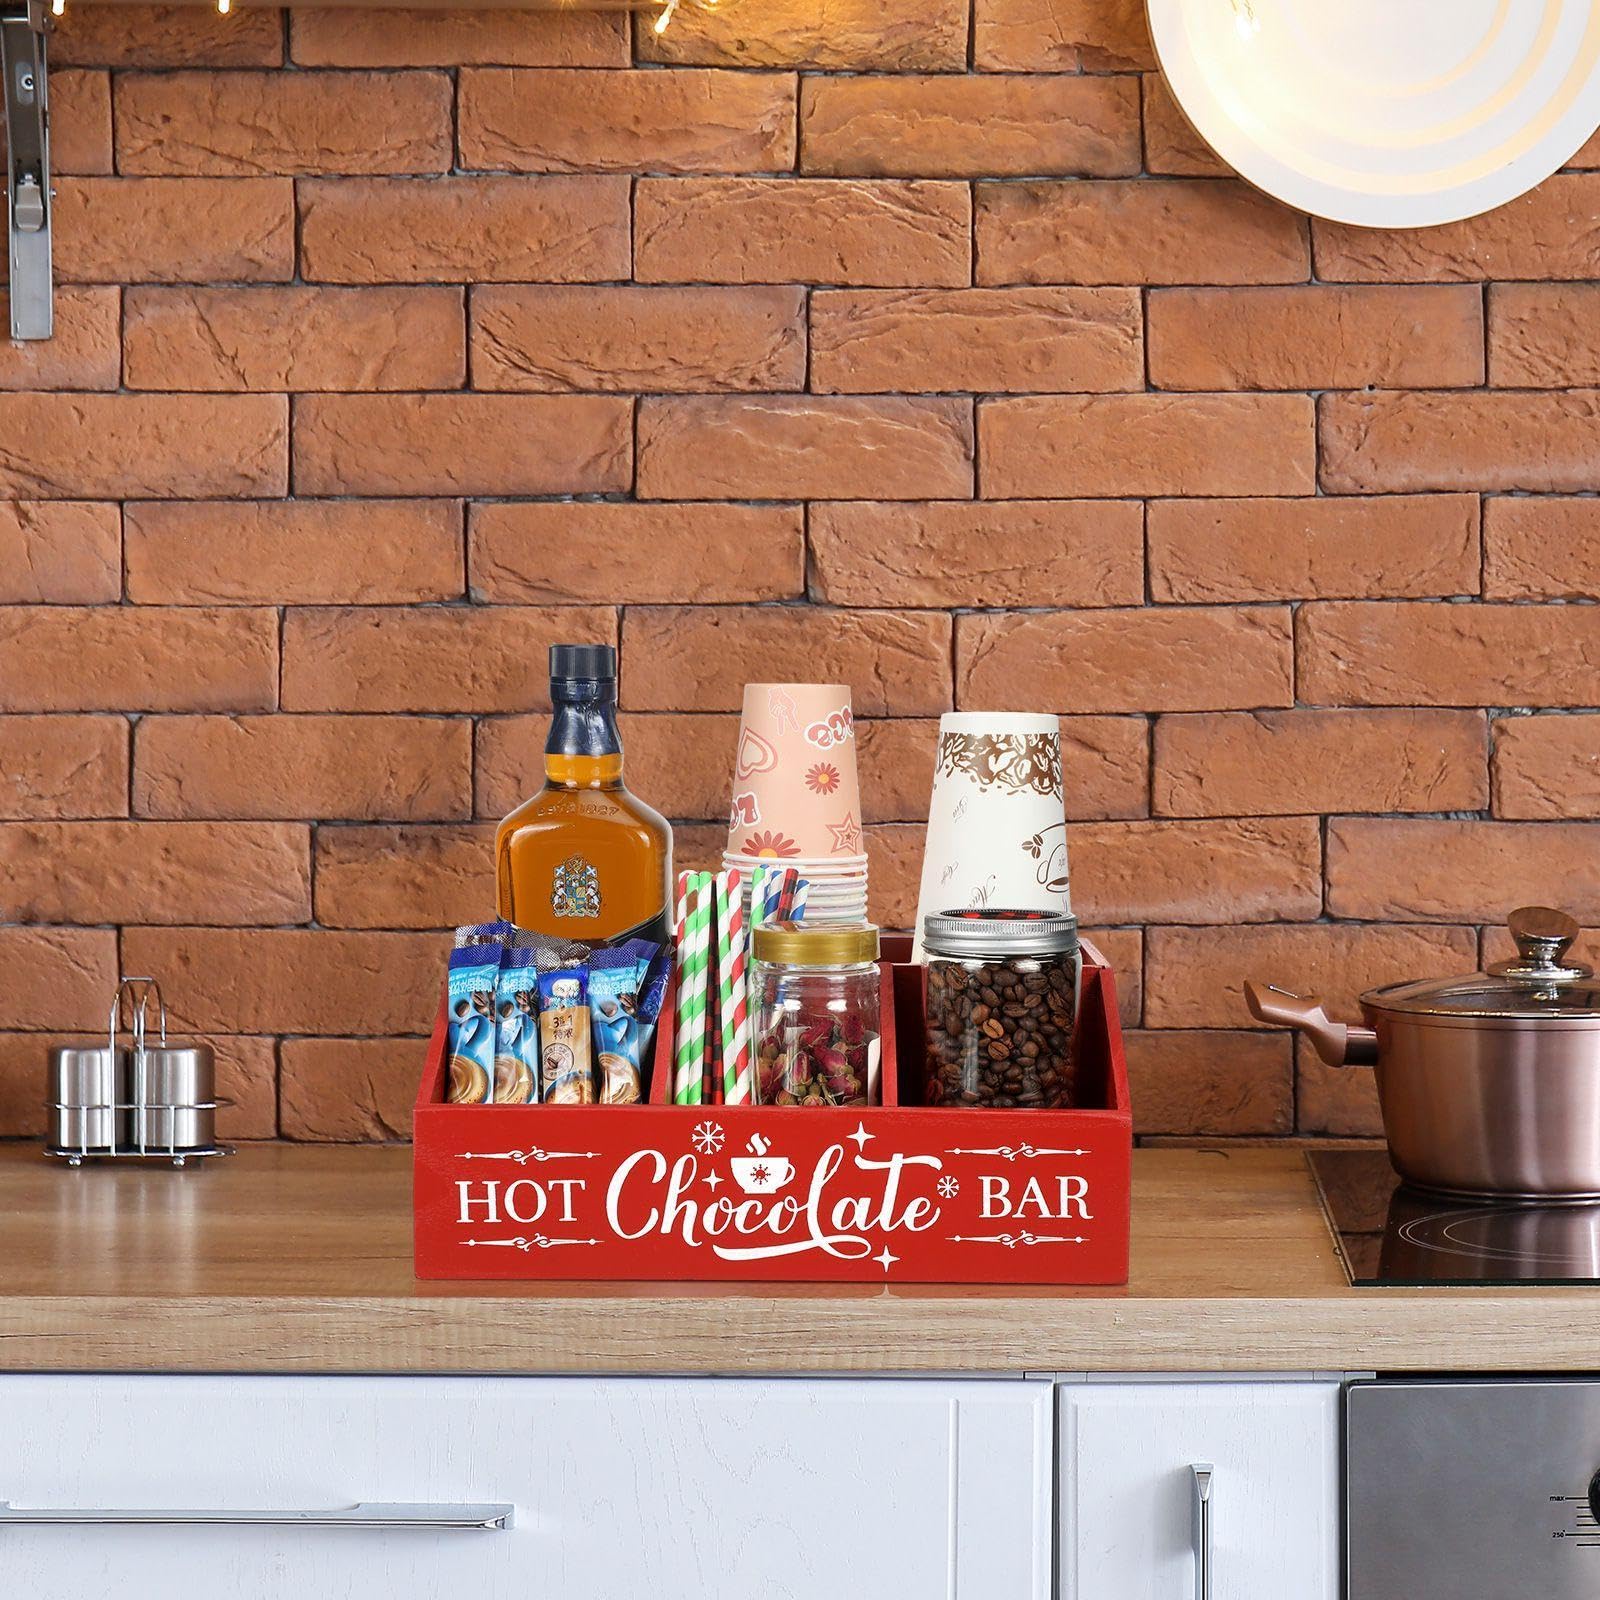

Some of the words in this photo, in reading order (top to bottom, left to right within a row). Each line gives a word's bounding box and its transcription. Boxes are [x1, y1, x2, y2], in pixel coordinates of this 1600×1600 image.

[454, 1179, 587, 1223] HOT
[605, 1144, 943, 1261] Chocolate
[977, 1175, 1094, 1220] BAR
